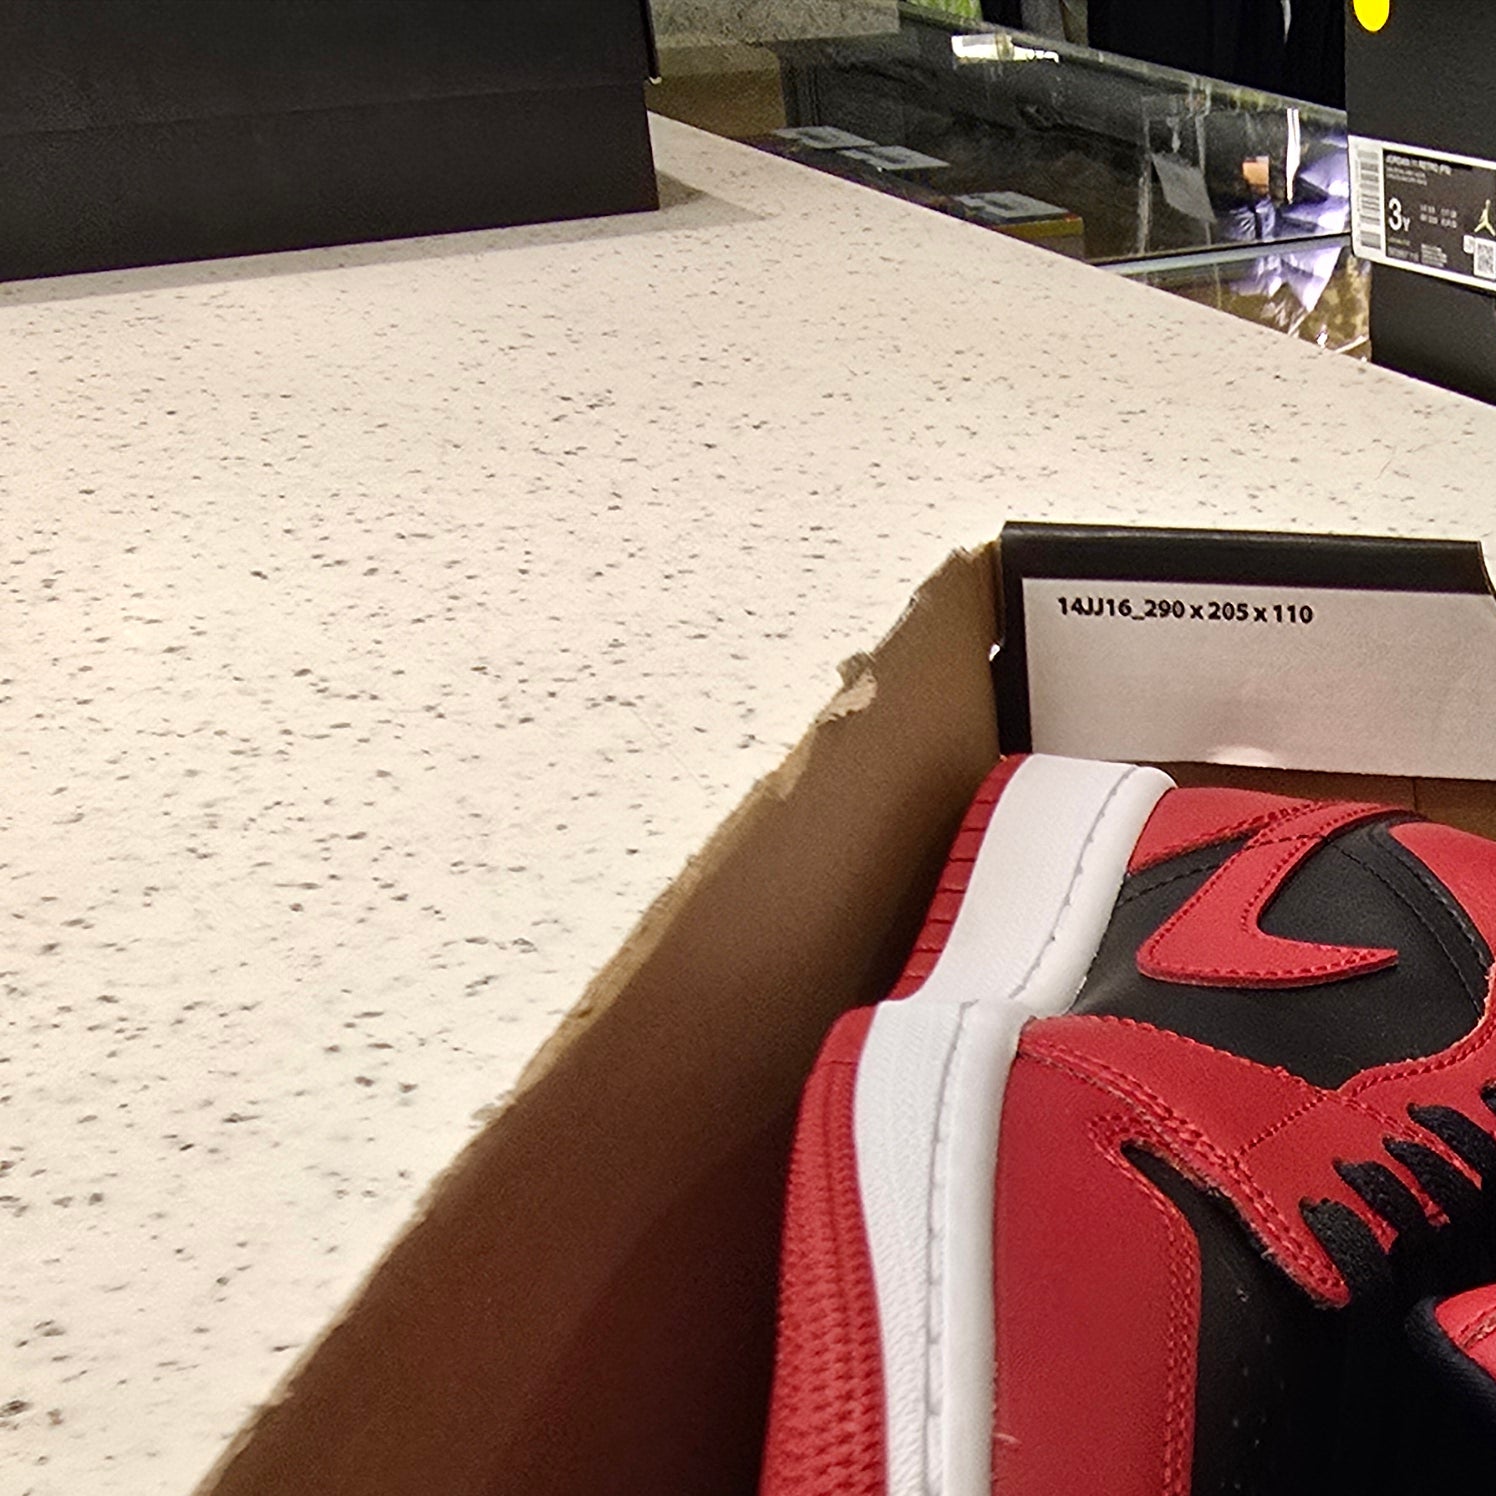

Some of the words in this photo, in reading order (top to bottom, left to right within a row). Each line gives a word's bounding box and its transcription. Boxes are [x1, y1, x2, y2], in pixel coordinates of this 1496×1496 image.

[1057, 597, 1186, 621] 14JJ16_290
[1190, 604, 1204, 620] x
[1208, 602, 1249, 621] 205
[1253, 606, 1267, 623] x
[1273, 604, 1313, 624] 110
